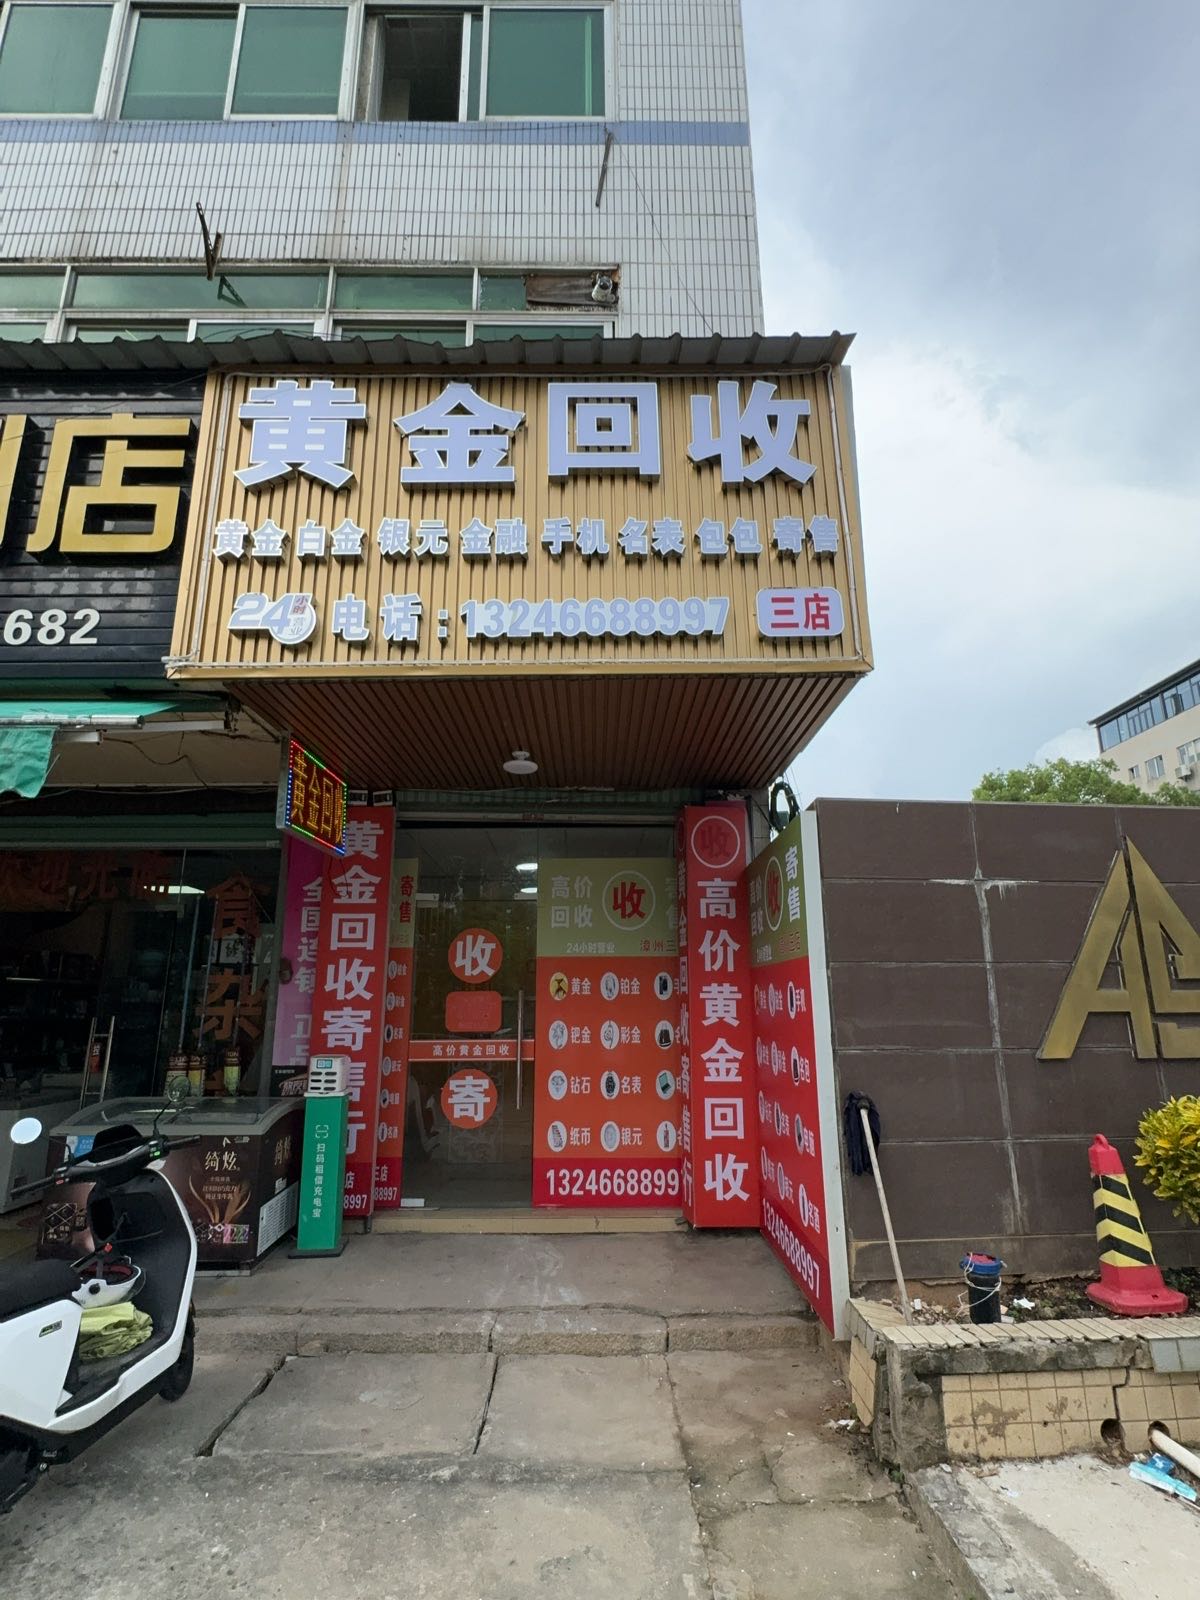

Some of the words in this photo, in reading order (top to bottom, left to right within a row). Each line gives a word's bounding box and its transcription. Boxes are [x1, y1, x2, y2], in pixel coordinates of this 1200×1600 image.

[234, 380, 818, 488] 黄金回收
[0, 413, 193, 554] 店
[213, 519, 290, 558] 黄金
[296, 519, 365, 558] 白金
[377, 517, 449, 557] 银元
[459, 517, 528, 556] 金融
[541, 517, 610, 556] 手机
[618, 517, 686, 556] 名表
[694, 517, 763, 555] 包包
[773, 515, 839, 554] 寄售
[3, 608, 101, 646] 682
[460, 597, 730, 638] 13246688997
[770, 593, 831, 631] 三店
[701, 826, 730, 858] 收
[399, 874, 414, 923] 寄售
[551, 876, 592, 899] 高价
[613, 881, 646, 919] 收
[785, 845, 801, 923] 寄售
[551, 904, 593, 928] 回收
[455, 935, 496, 977] 收
[193, 873, 272, 1098] 食杂
[570, 978, 592, 996] 黄金
[620, 978, 641, 996] 铂金
[432, 1043, 510, 1057] 高价黄金回收
[570, 1026, 592, 1045] 钯金
[620, 1026, 641, 1045] 彩金
[697, 877, 750, 1201] 高价黄金回收
[448, 1075, 491, 1122] 寄
[570, 1076, 591, 1094] 钻石
[620, 1076, 642, 1094] 名表
[569, 1128, 591, 1146] 纸币
[620, 1127, 643, 1146] 银元
[205, 1151, 237, 1172] 绮炫
[312, 1143, 326, 1218] 扫码租借充电宝
[546, 1168, 682, 1197] 1324668899
[763, 1198, 820, 1299] 13246688997
